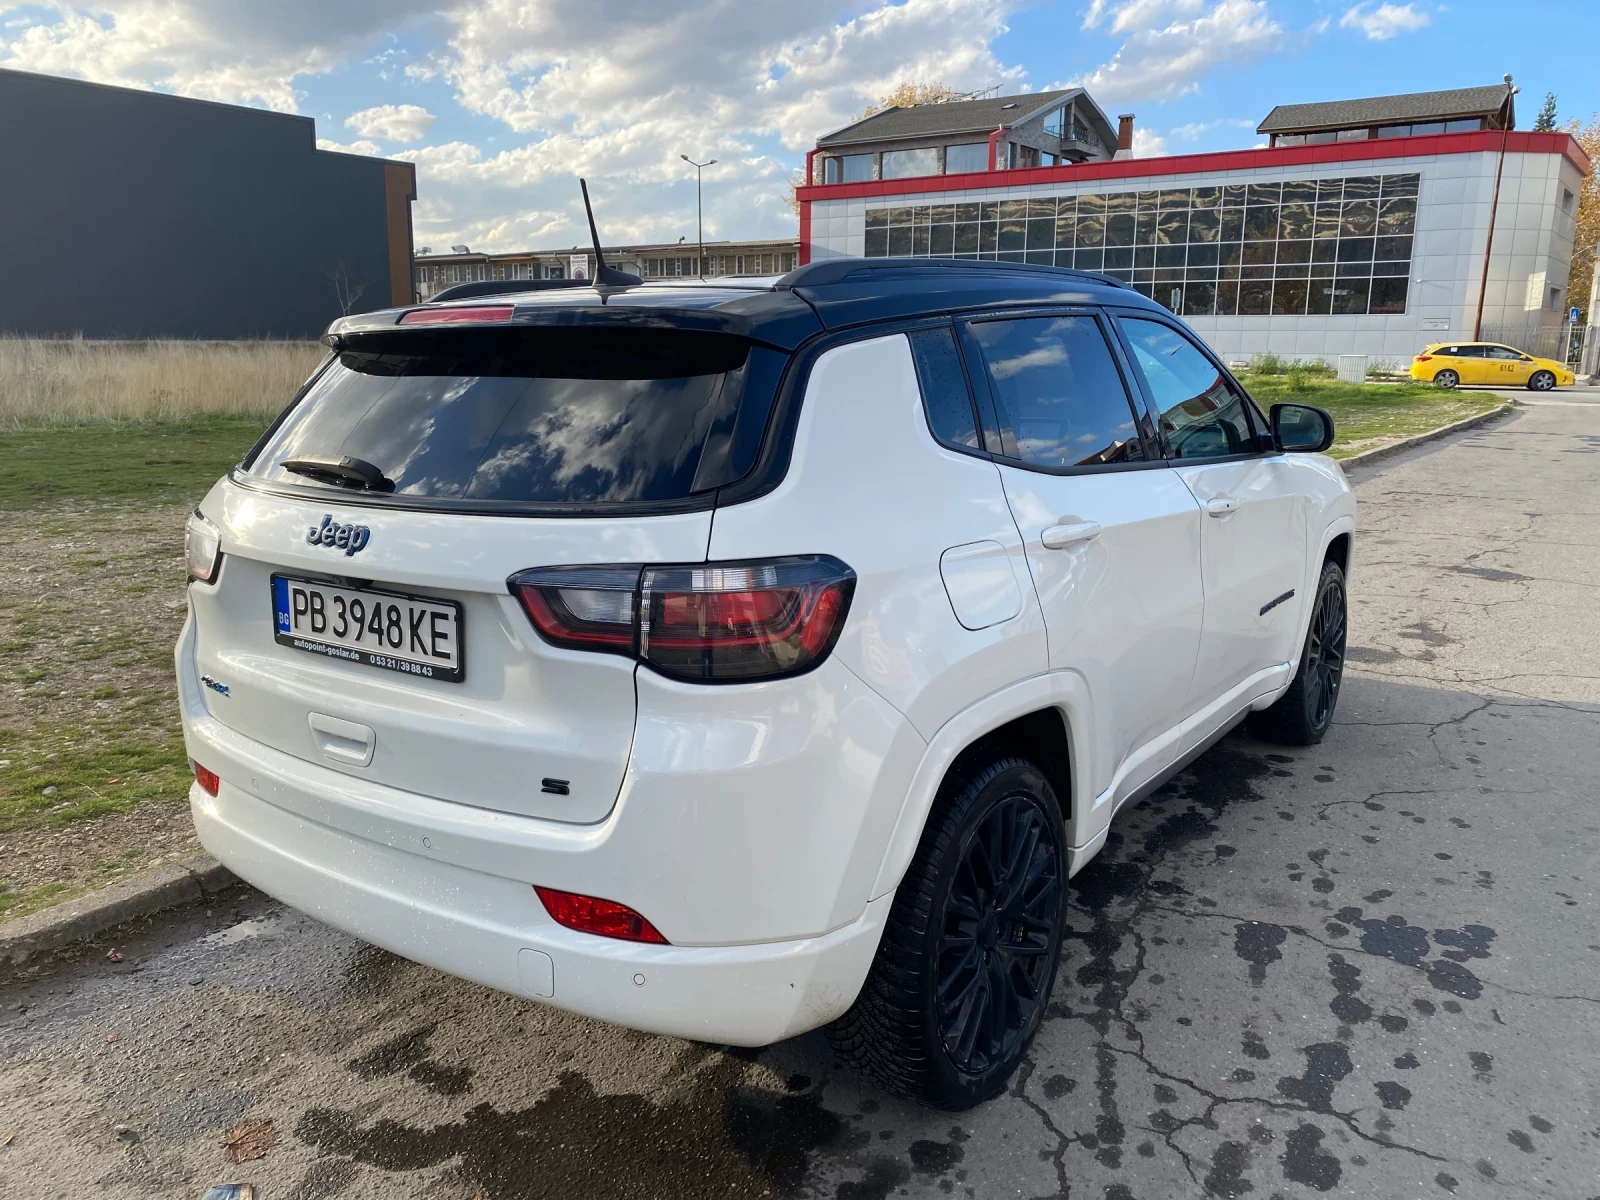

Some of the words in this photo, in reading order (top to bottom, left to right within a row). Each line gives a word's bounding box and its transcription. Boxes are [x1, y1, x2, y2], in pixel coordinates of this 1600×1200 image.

[306, 514, 371, 557] Jeep
[278, 611, 290, 625] BG
[294, 639, 360, 661] autopoint-goslar.de
